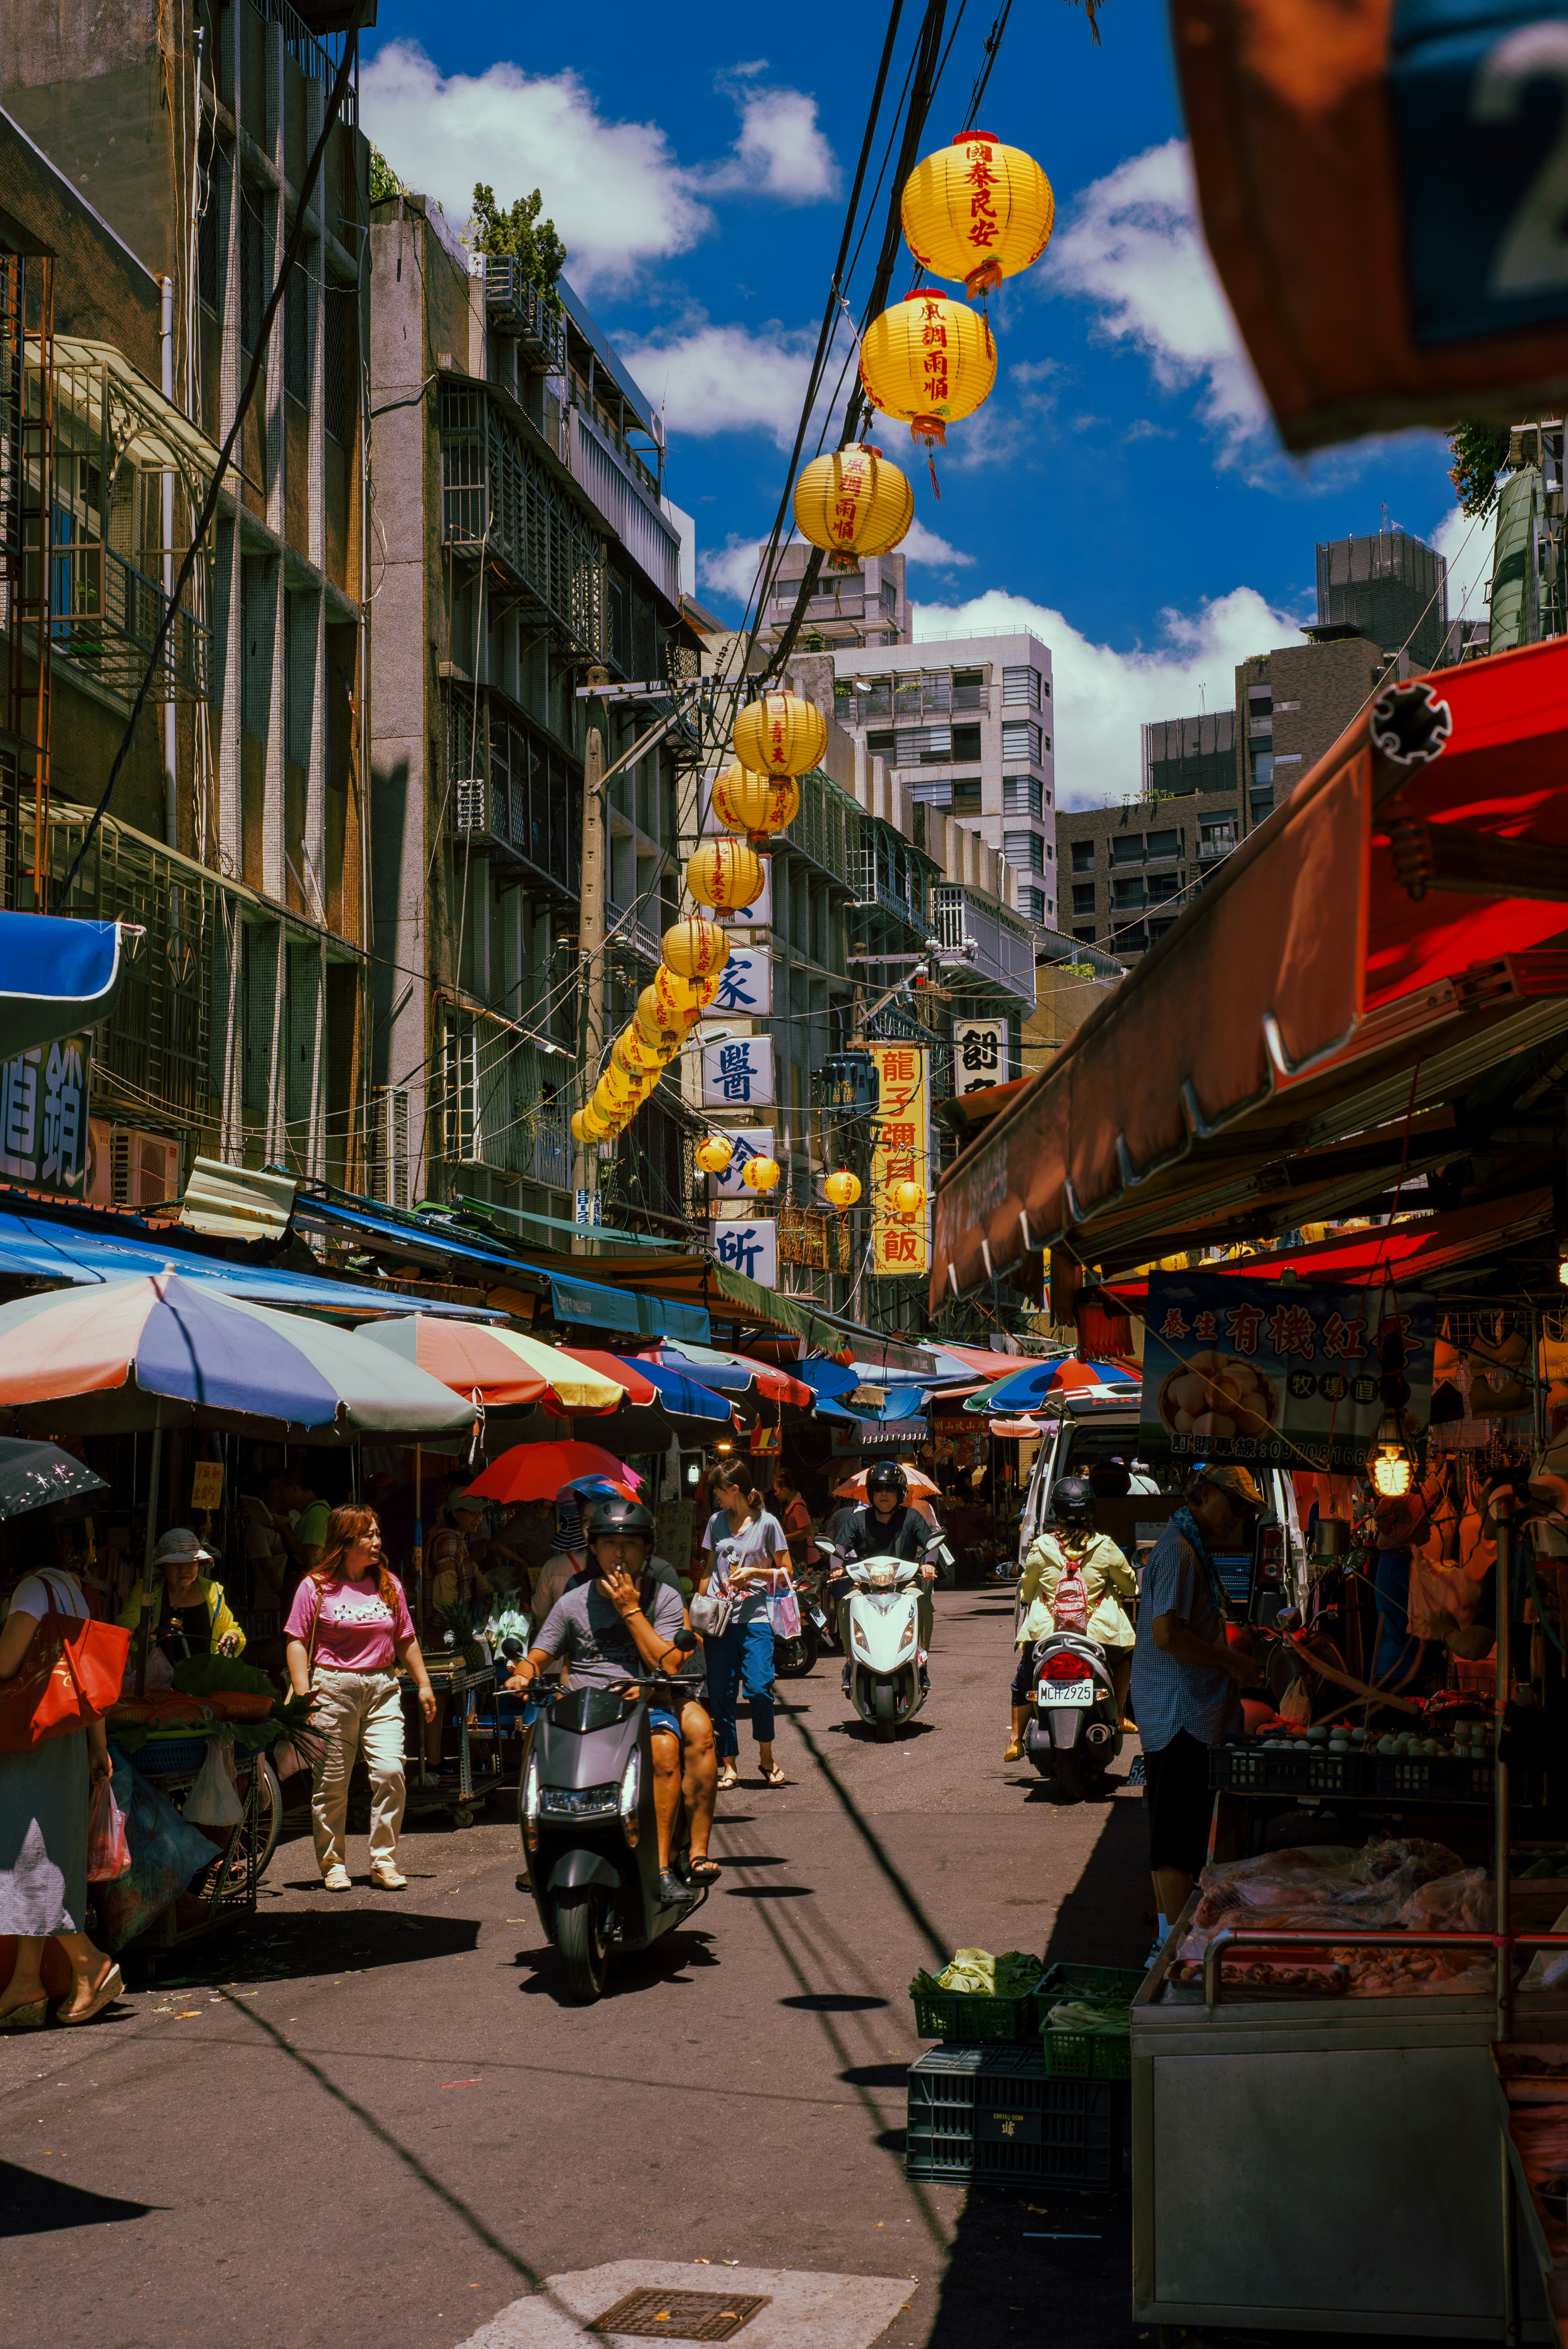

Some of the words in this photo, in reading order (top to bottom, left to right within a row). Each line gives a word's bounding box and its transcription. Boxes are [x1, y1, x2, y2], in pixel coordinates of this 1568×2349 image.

[965, 145, 1000, 247] 國泰民安
[918, 304, 947, 400] 風調雨順
[832, 458, 866, 540] 風調雨順
[1292, 1375, 1375, 1401] 牧場直
[973, 1434, 982, 1465] 甘蔗雞
